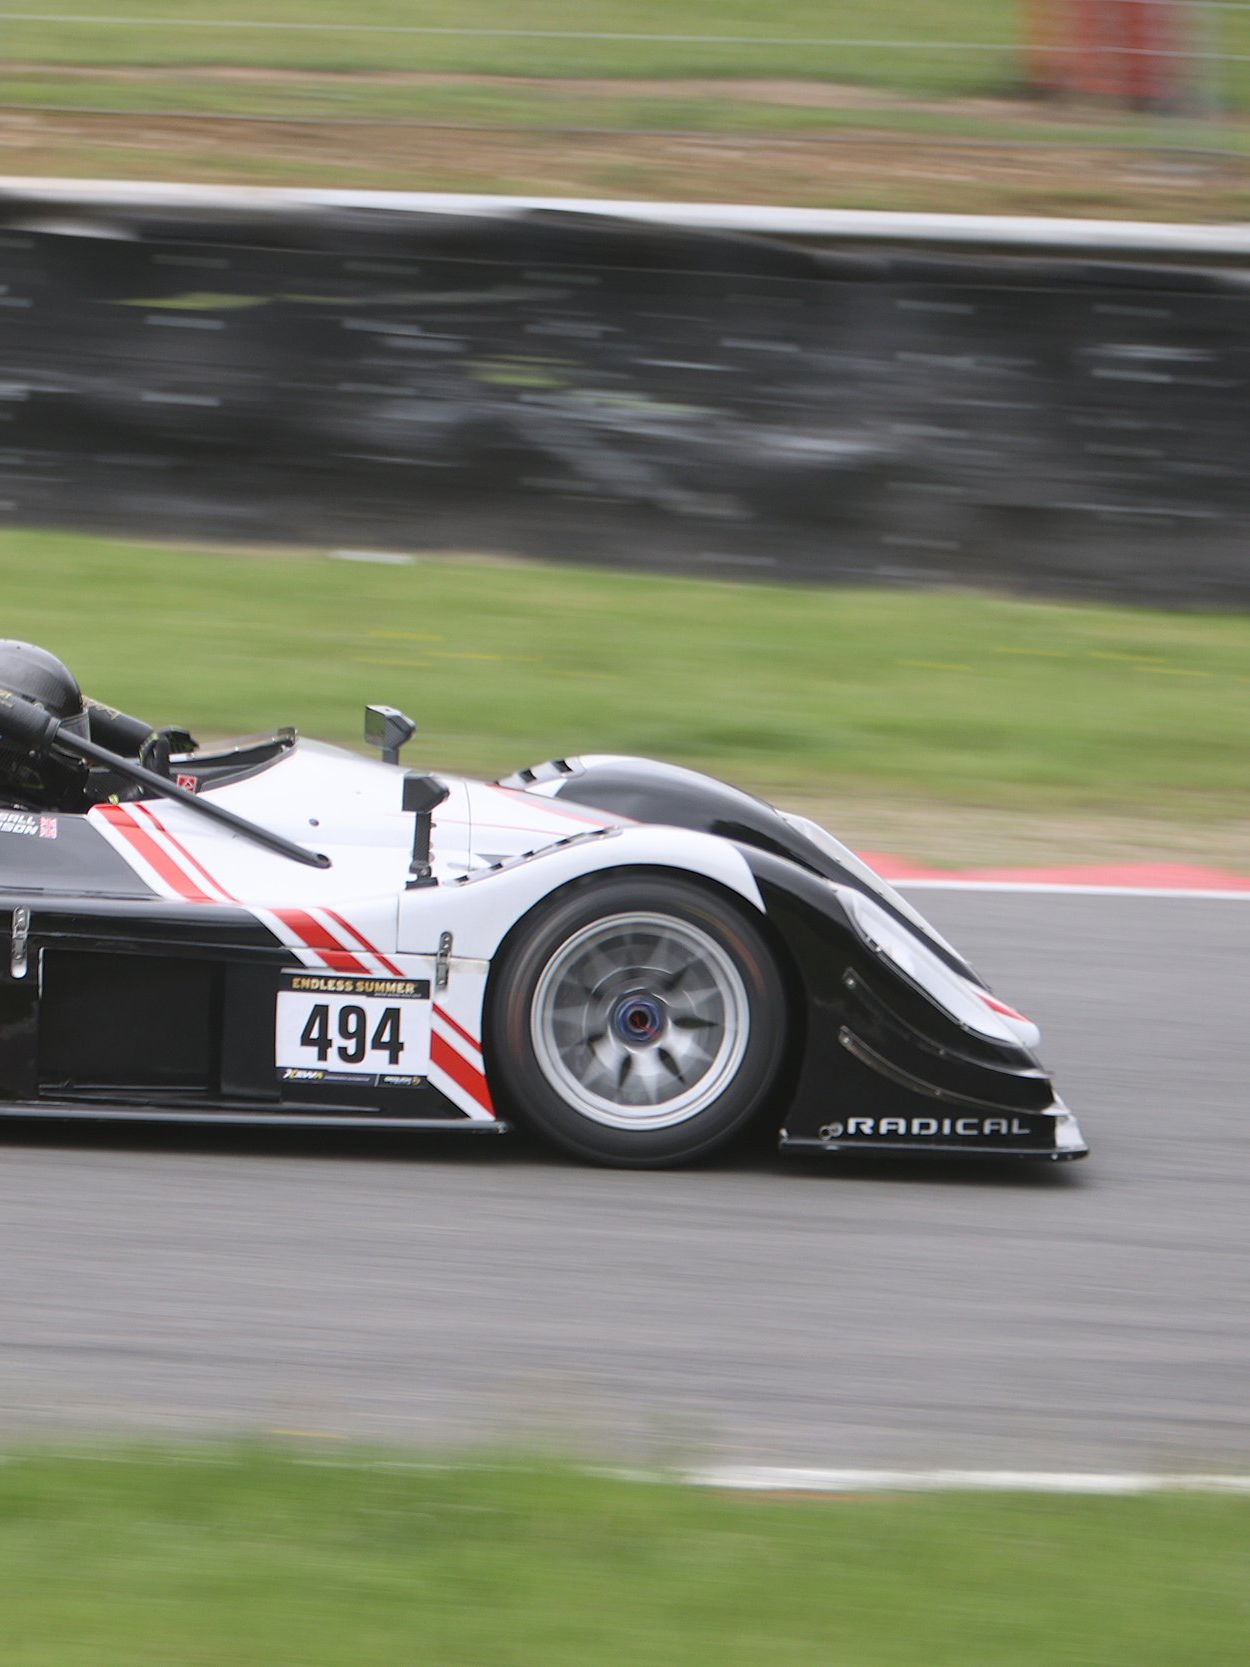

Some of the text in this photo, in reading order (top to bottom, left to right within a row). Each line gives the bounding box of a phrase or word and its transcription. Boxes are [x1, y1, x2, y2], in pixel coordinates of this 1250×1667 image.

[291, 977, 416, 995] ENDLESS SUMMER
[300, 1003, 405, 1066] 494
[847, 1117, 1031, 1136] RADICAL
